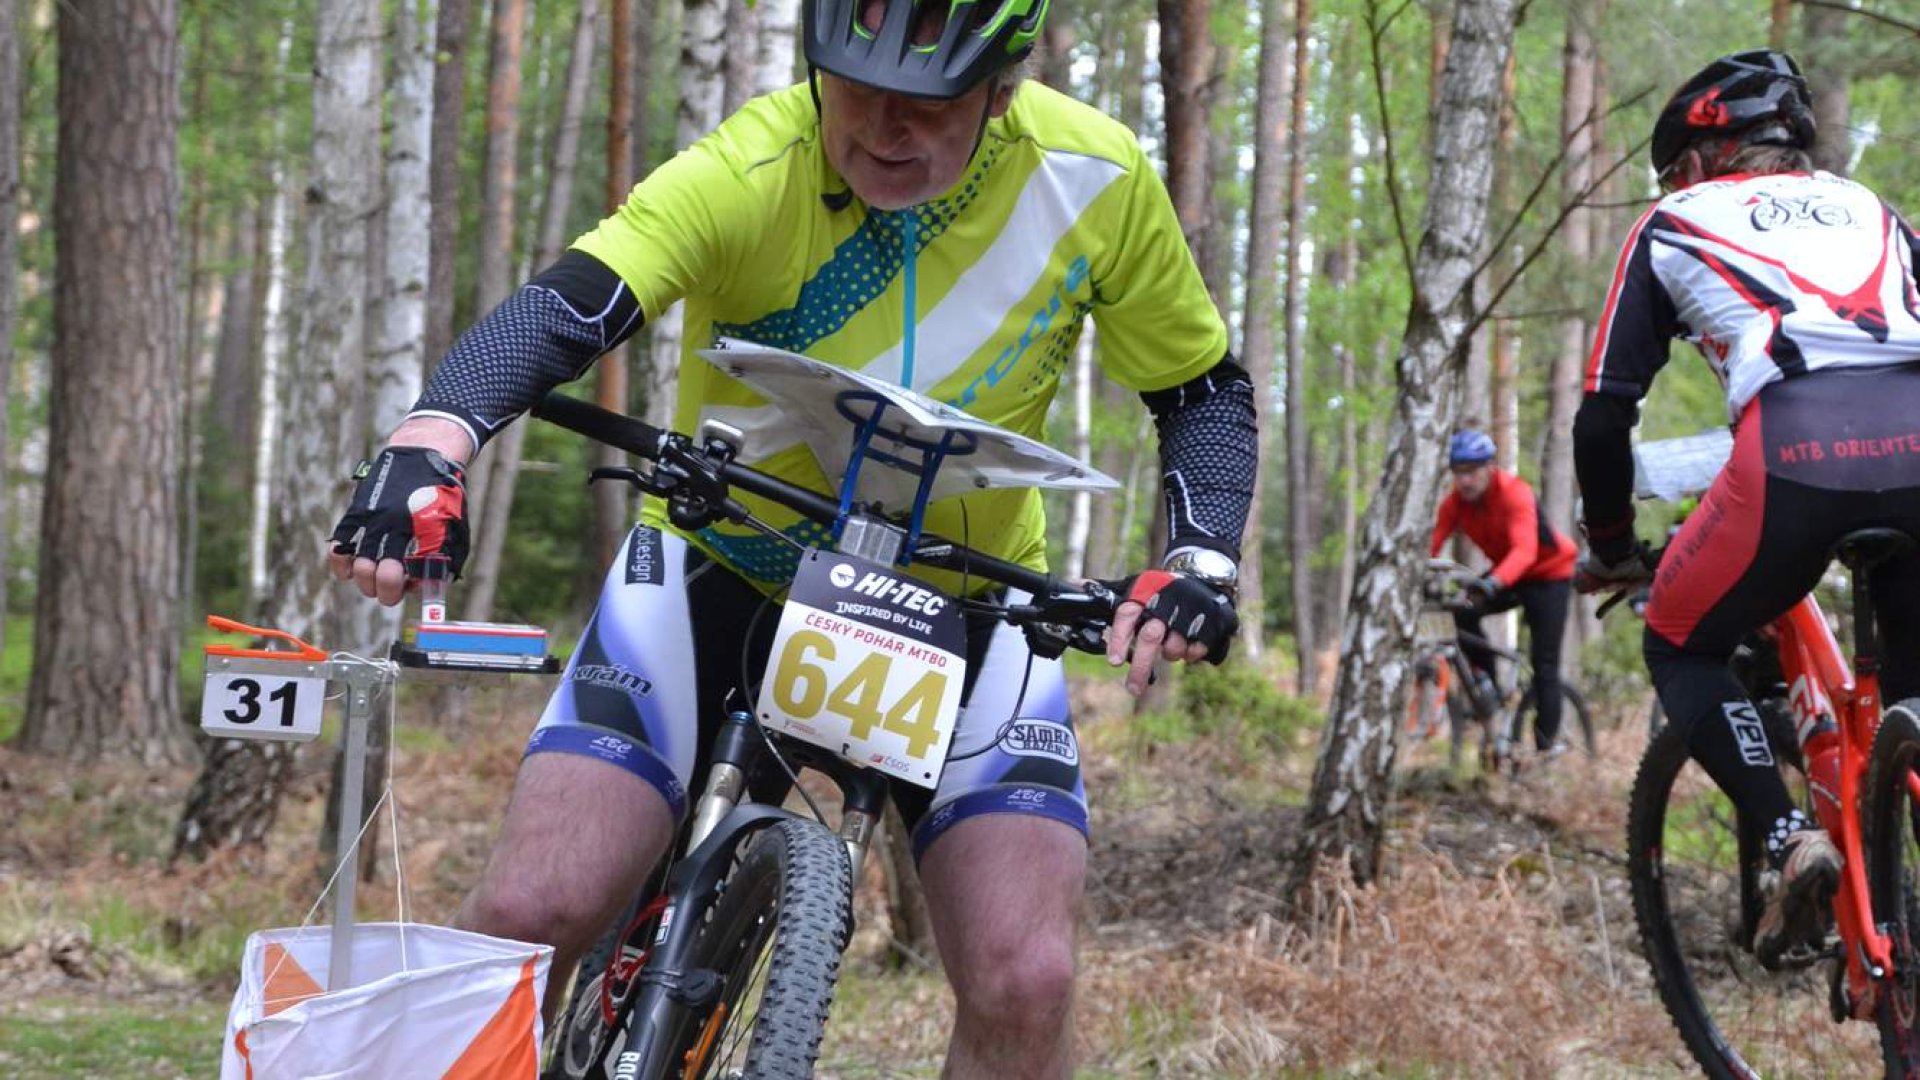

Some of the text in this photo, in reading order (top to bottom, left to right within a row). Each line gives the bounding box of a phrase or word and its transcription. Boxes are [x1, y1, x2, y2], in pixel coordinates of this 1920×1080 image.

[1780, 440, 1824, 463] MTB
[853, 572, 945, 616] HI-TEC
[805, 611, 947, 667] ČESKÝ POHÁR MTBO
[835, 601, 933, 635] INSPIRED BY LIFE
[223, 678, 298, 727] 31
[772, 630, 948, 759] 644
